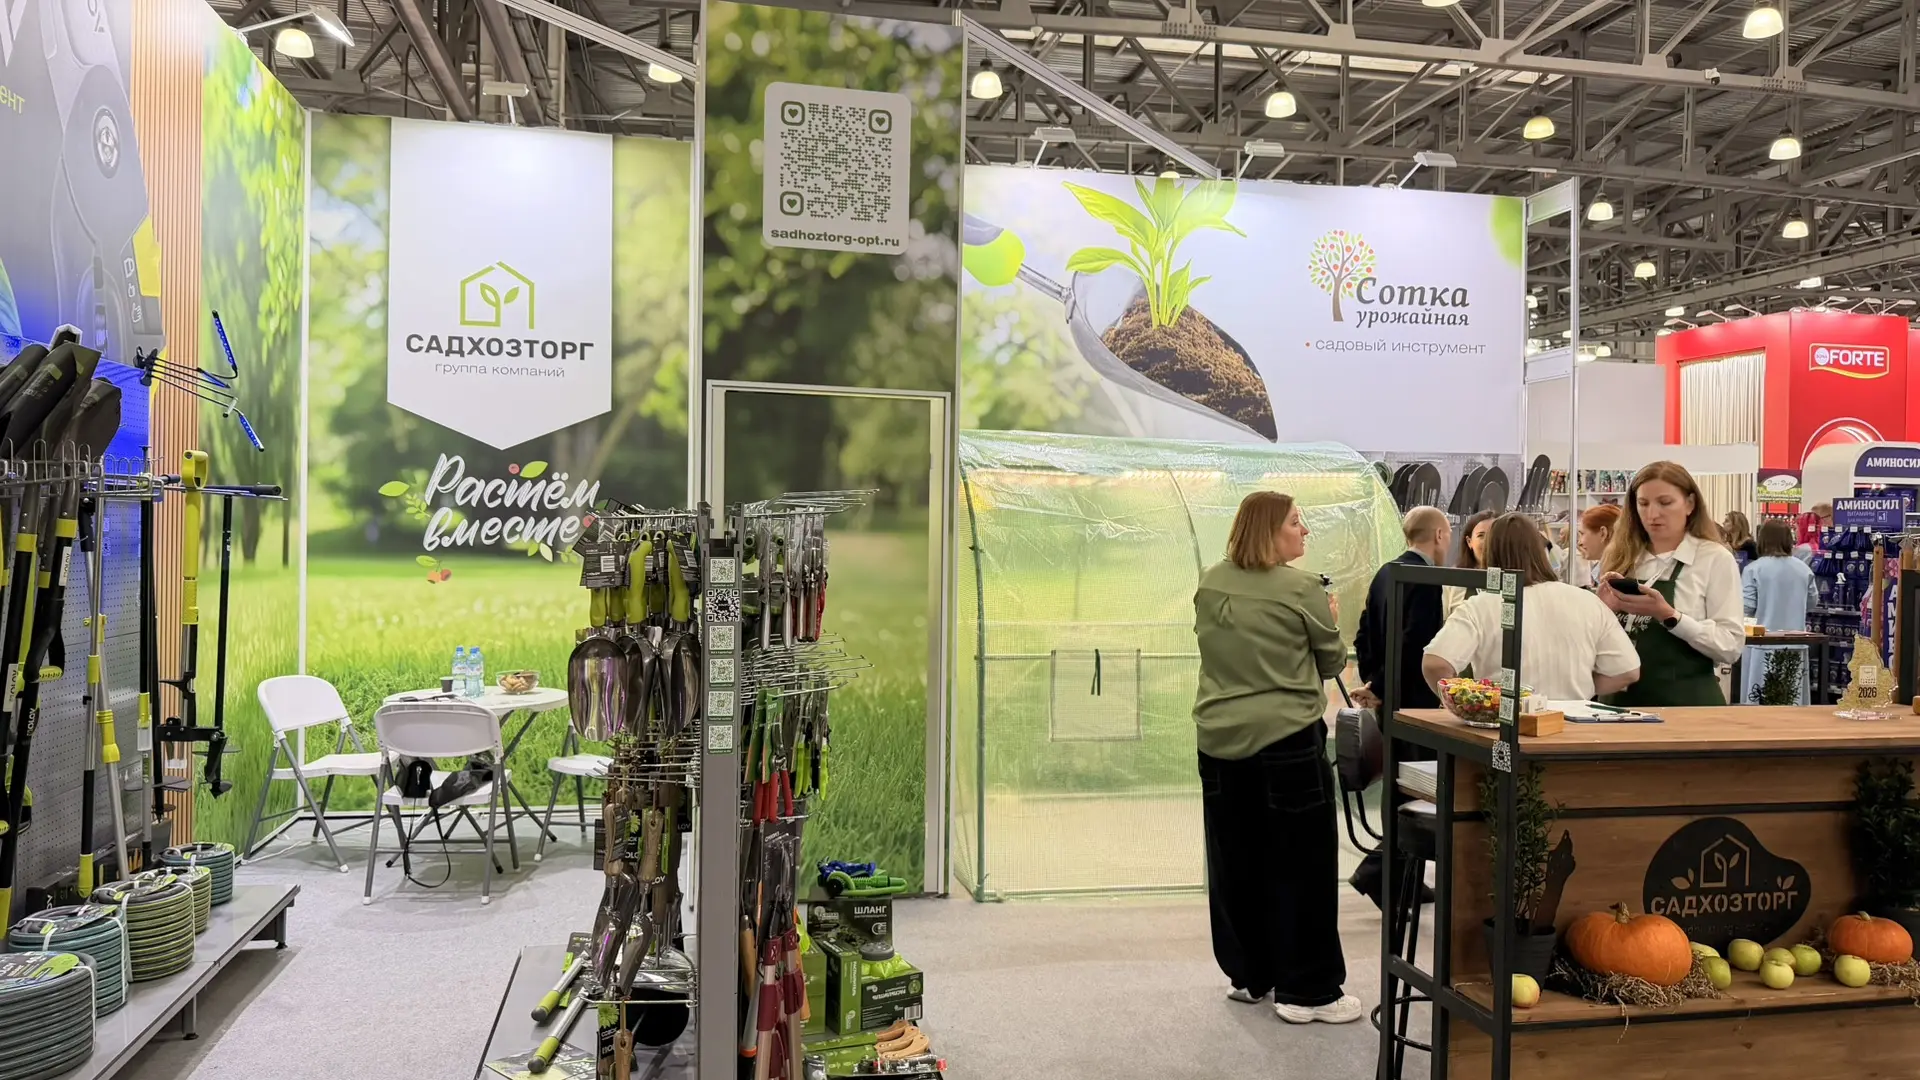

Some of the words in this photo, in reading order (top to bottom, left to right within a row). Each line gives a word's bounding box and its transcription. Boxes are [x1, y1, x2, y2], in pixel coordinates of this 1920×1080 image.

[771, 229, 900, 247] sadhoztorg-opt.ru
[1356, 277, 1470, 307] Сотка
[1356, 308, 1469, 328] урожайная
[405, 333, 595, 361] САДХОЗТОРГ
[1315, 339, 1387, 352] садовый
[1391, 342, 1487, 356] инструмент
[1830, 349, 1884, 367] FORTE
[435, 362, 487, 376] группа
[492, 367, 565, 378] компаний
[424, 452, 600, 510] Растём
[1836, 500, 1899, 510] АМИНОСИЛ
[422, 507, 581, 552] вместе
[1858, 687, 1877, 698] 2026
[854, 905, 887, 915] ШЛАНГ
[1651, 891, 1798, 918] САДХОЗТОРГ
